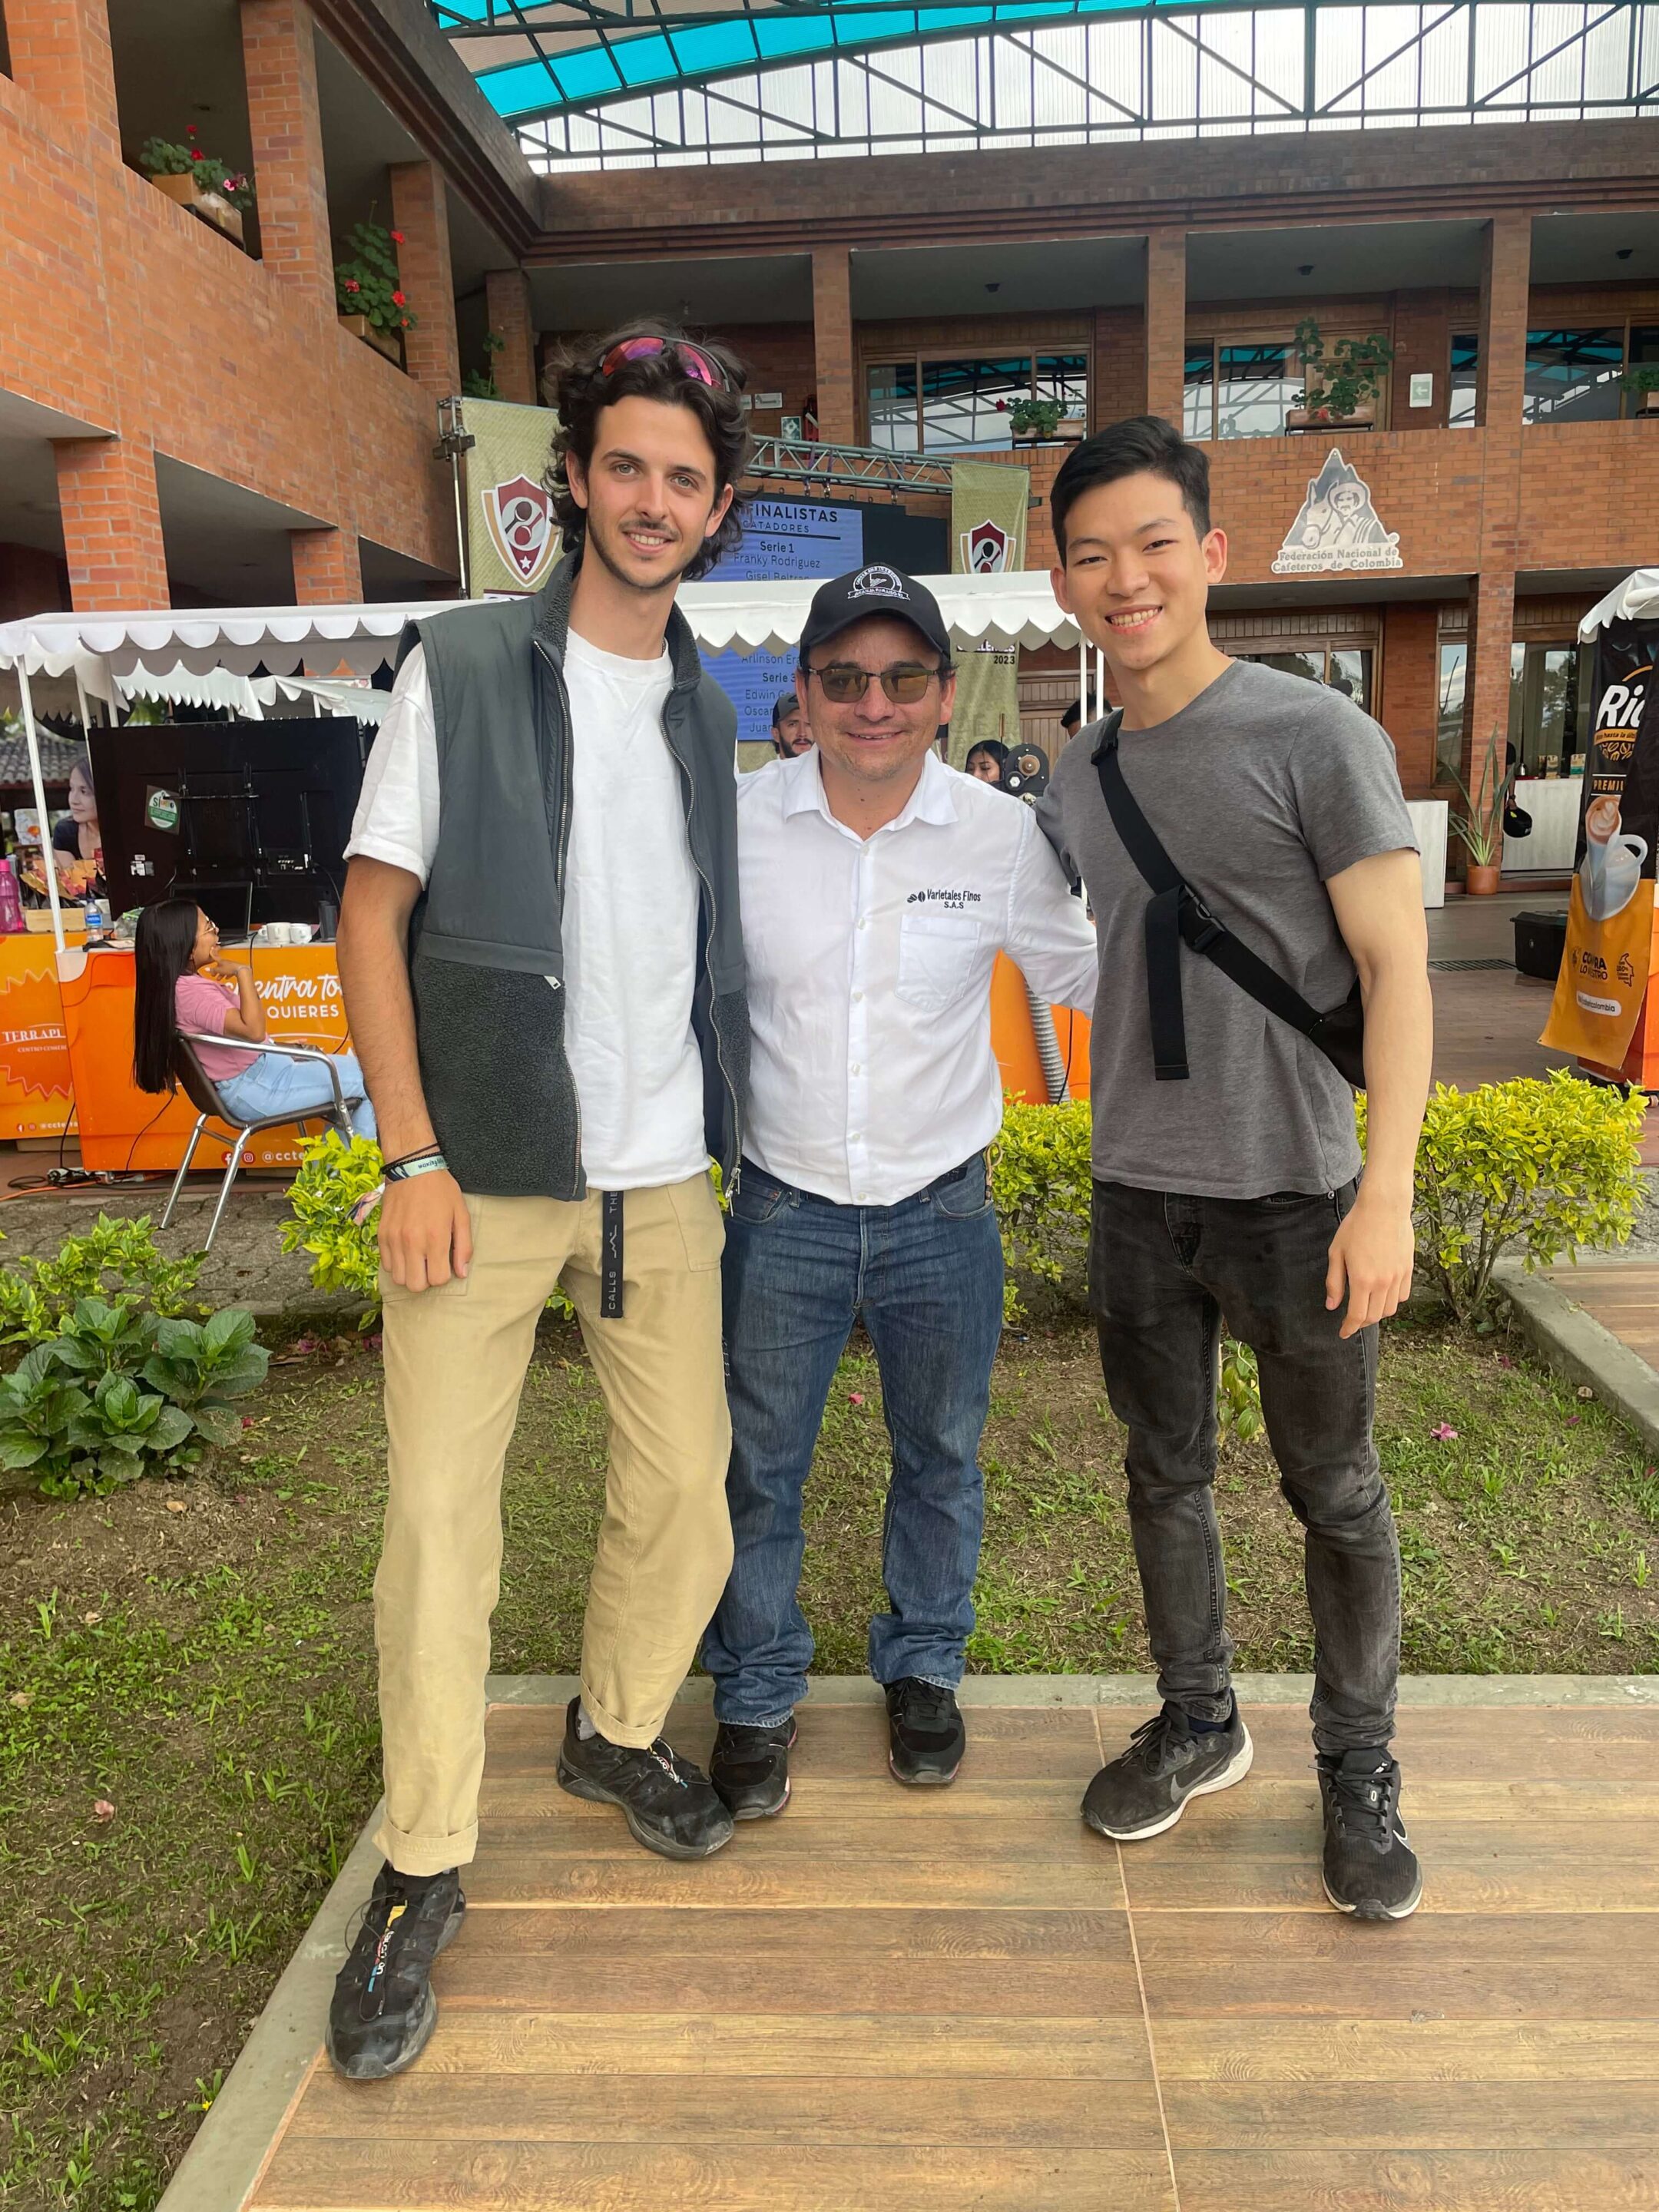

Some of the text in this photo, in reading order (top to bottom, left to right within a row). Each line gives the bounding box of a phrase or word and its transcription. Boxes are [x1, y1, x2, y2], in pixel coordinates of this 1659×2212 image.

[743, 520, 810, 533] CATADORES
[760, 541, 795, 553] Serie 1
[734, 552, 820, 569] Franky Rodriguez
[1280, 547, 1397, 561] Federación Nacional de
[1273, 558, 1401, 572] Cafeteros de Colombia
[746, 570, 770, 581] Gisel
[993, 655, 1015, 664] 2023
[762, 672, 788, 683] Serie
[745, 689, 775, 700] Edwin
[744, 706, 773, 716] Oscar
[926, 889, 982, 902] Varietales Finos
[944, 901, 964, 909] S.A.S
[317, 973, 343, 1001] to
[267, 1005, 339, 1019] QUIERES
[608, 1191, 618, 1310] CALLS THE
